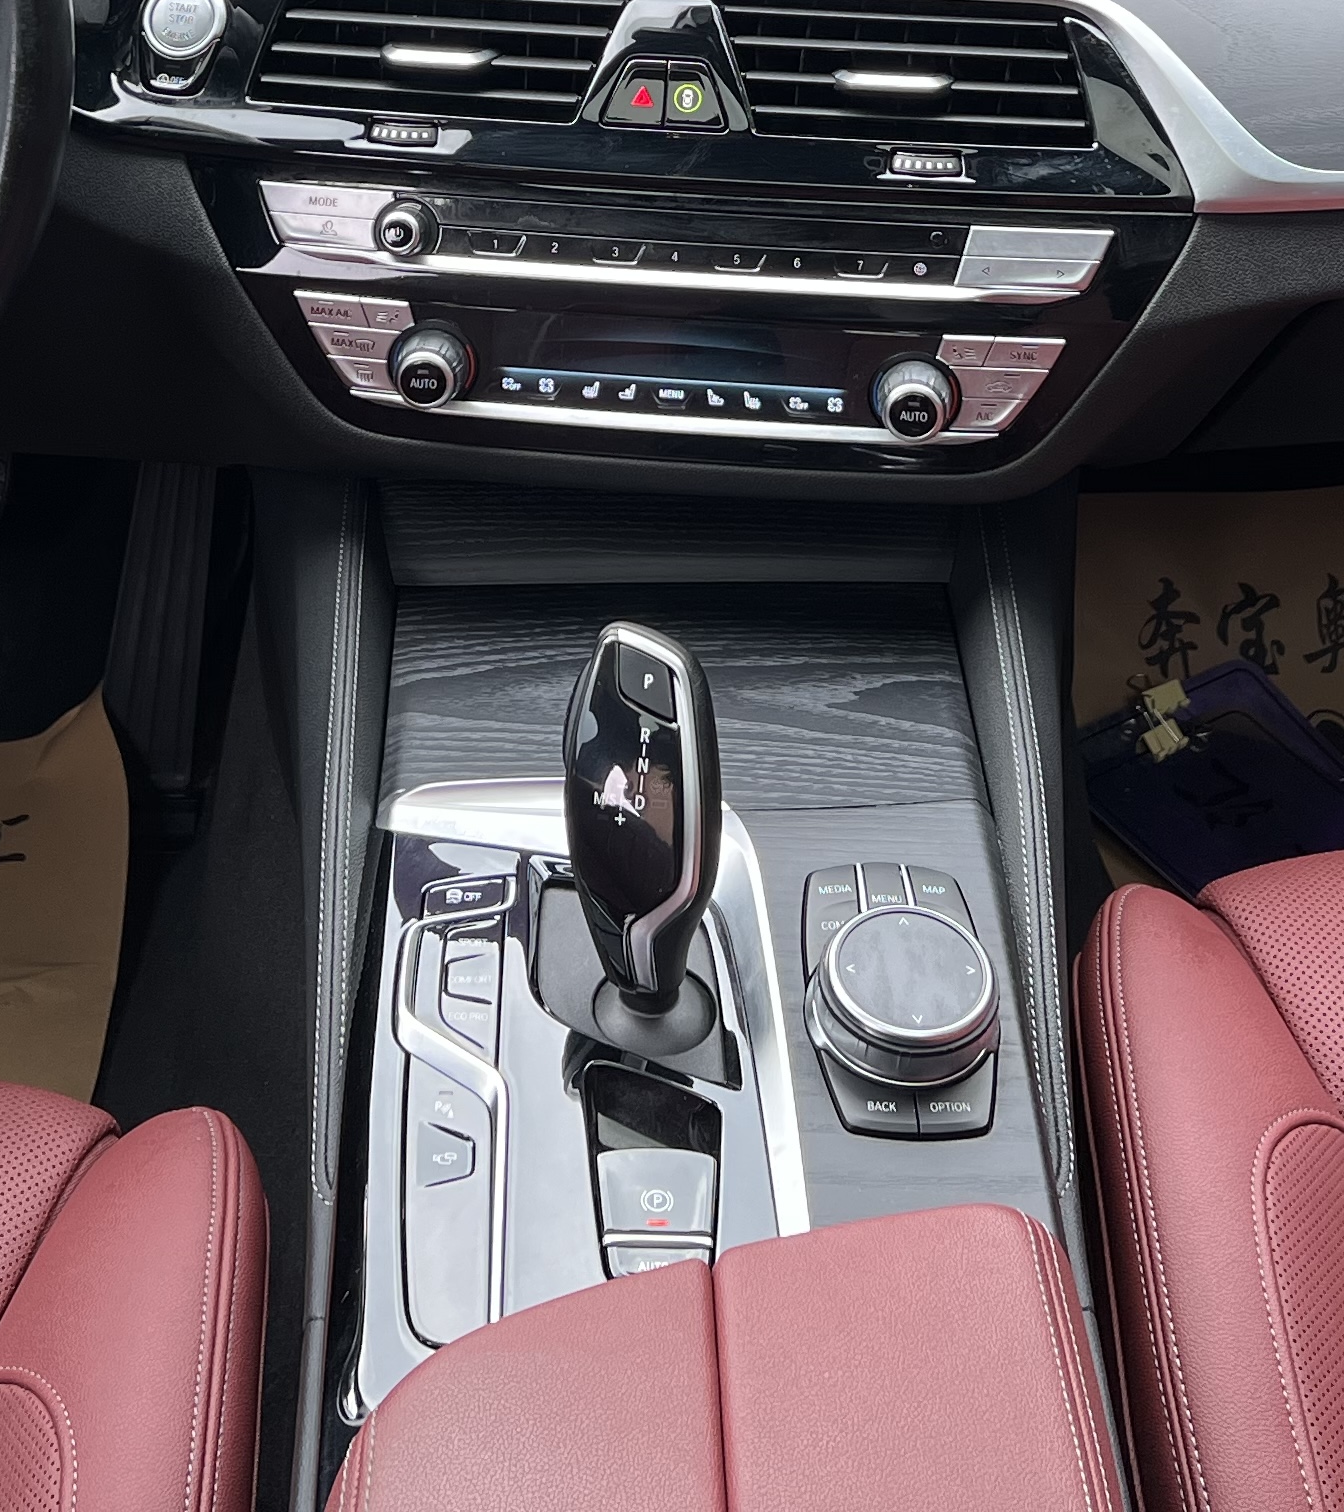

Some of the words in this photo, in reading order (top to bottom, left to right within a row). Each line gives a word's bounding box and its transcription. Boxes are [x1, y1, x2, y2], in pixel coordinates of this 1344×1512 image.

[169, 2, 199, 14] START
[169, 13, 194, 25] STOP
[308, 195, 339, 208] MODE
[492, 239, 499, 250] 1
[551, 241, 559, 254] 2
[611, 246, 620, 258] 3
[671, 251, 679, 263] 4
[733, 254, 741, 265] 5
[793, 257, 802, 269] 6
[857, 260, 865, 271] 7
[310, 306, 334, 317] MAX
[330, 337, 354, 348] MAX
[1009, 350, 1038, 362] SYNC
[409, 377, 438, 390] AUTO
[658, 387, 686, 400] MENU
[899, 410, 928, 422] AUTO
[643, 673, 654, 689] P
[640, 727, 650, 744] R
[637, 757, 649, 774] N
[634, 794, 646, 811] D
[818, 884, 853, 895] MEDIA
[922, 884, 946, 895] MAP
[463, 891, 482, 902] OFF
[871, 894, 903, 904] MENU
[457, 938, 488, 947] SPORT
[449, 974, 492, 985] COMFORT
[448, 1011, 467, 1022] ECO
[469, 1011, 489, 1022] PRO
[867, 1100, 897, 1113] BACK
[929, 1101, 971, 1113] OPTION
